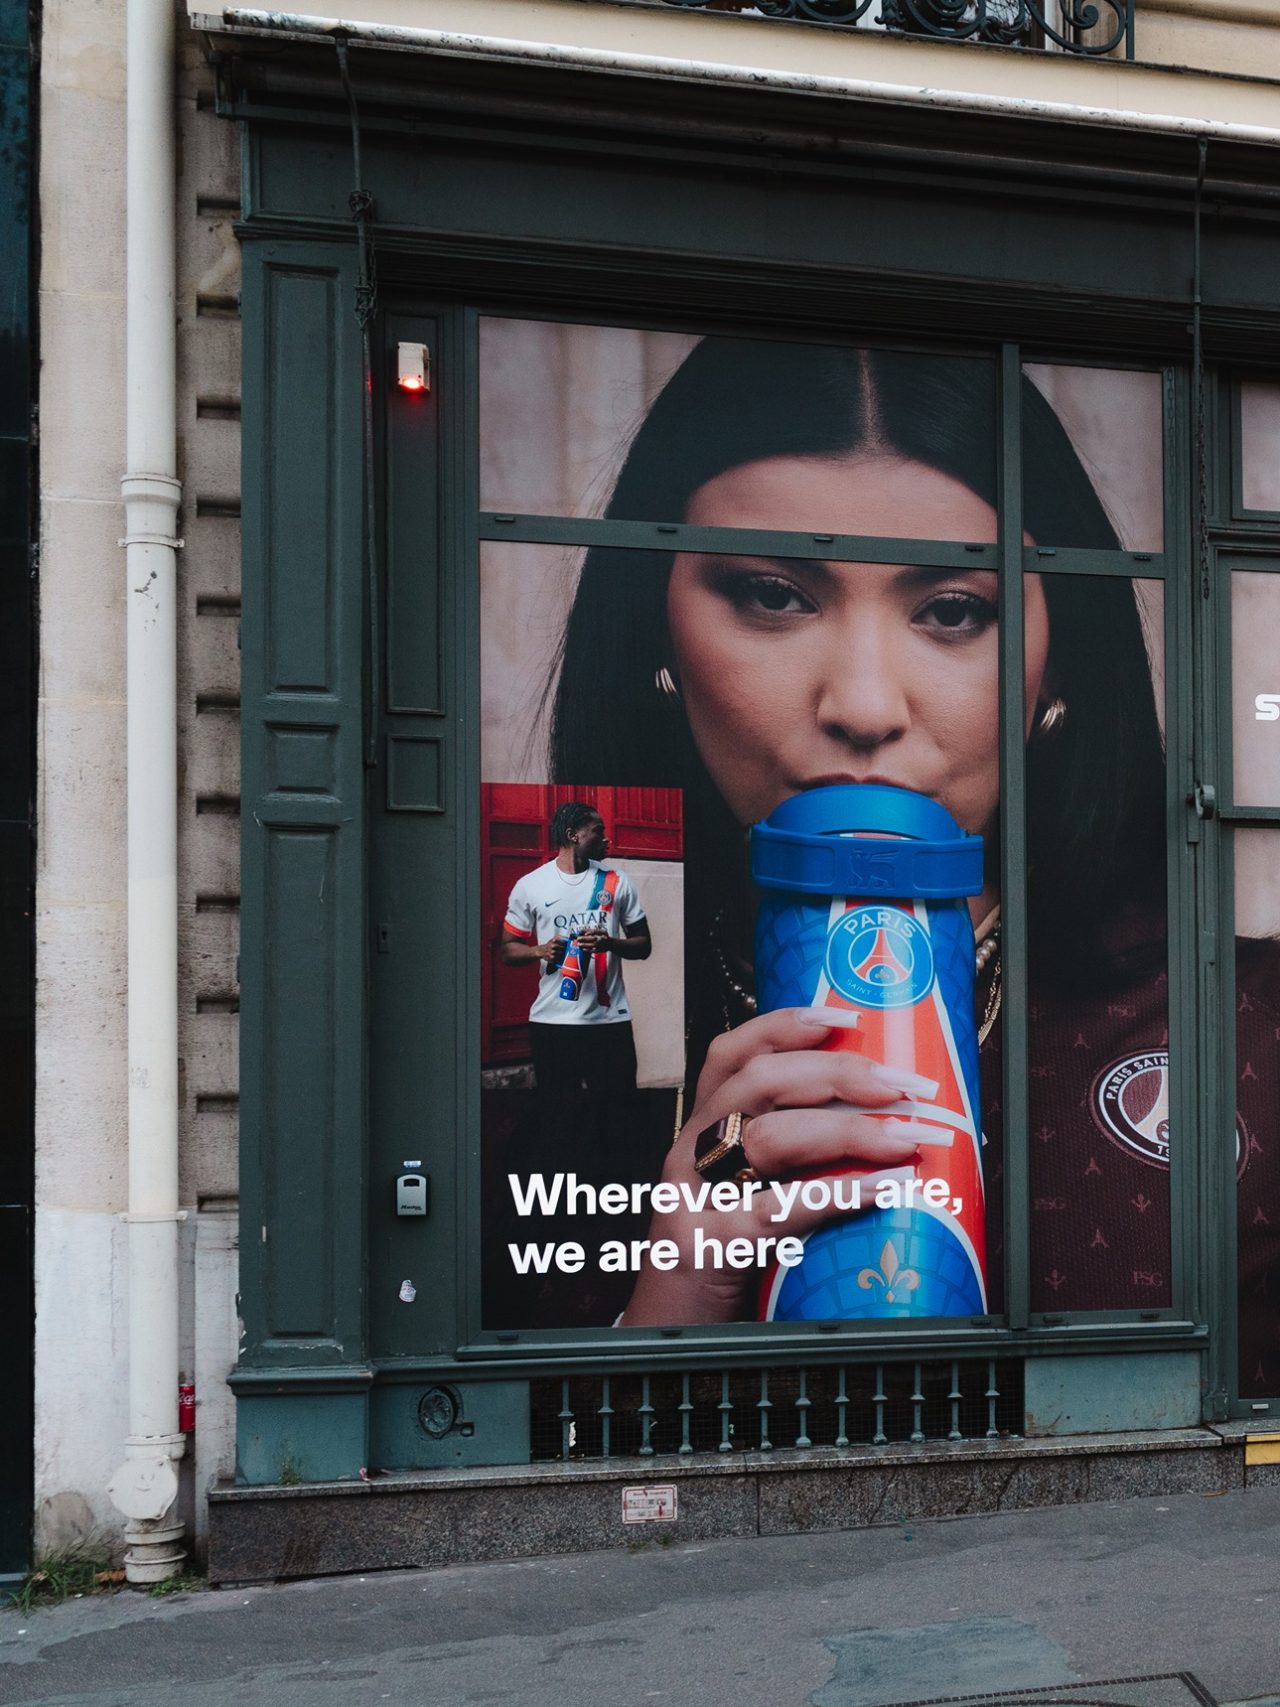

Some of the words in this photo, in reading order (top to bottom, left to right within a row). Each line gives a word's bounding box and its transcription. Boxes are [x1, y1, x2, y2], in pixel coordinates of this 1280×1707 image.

[554, 911, 608, 930] QATAR
[842, 911, 917, 939] PARIS
[847, 978, 872, 996] SAINT
[1106, 1067, 1133, 1100] PARIS
[1133, 1057, 1169, 1070] SAIN
[508, 1172, 761, 1217] Wherever
[771, 1177, 861, 1222] you
[876, 1175, 963, 1217] are,
[508, 1240, 586, 1275] we
[599, 1238, 680, 1273] are
[693, 1227, 805, 1271] here
